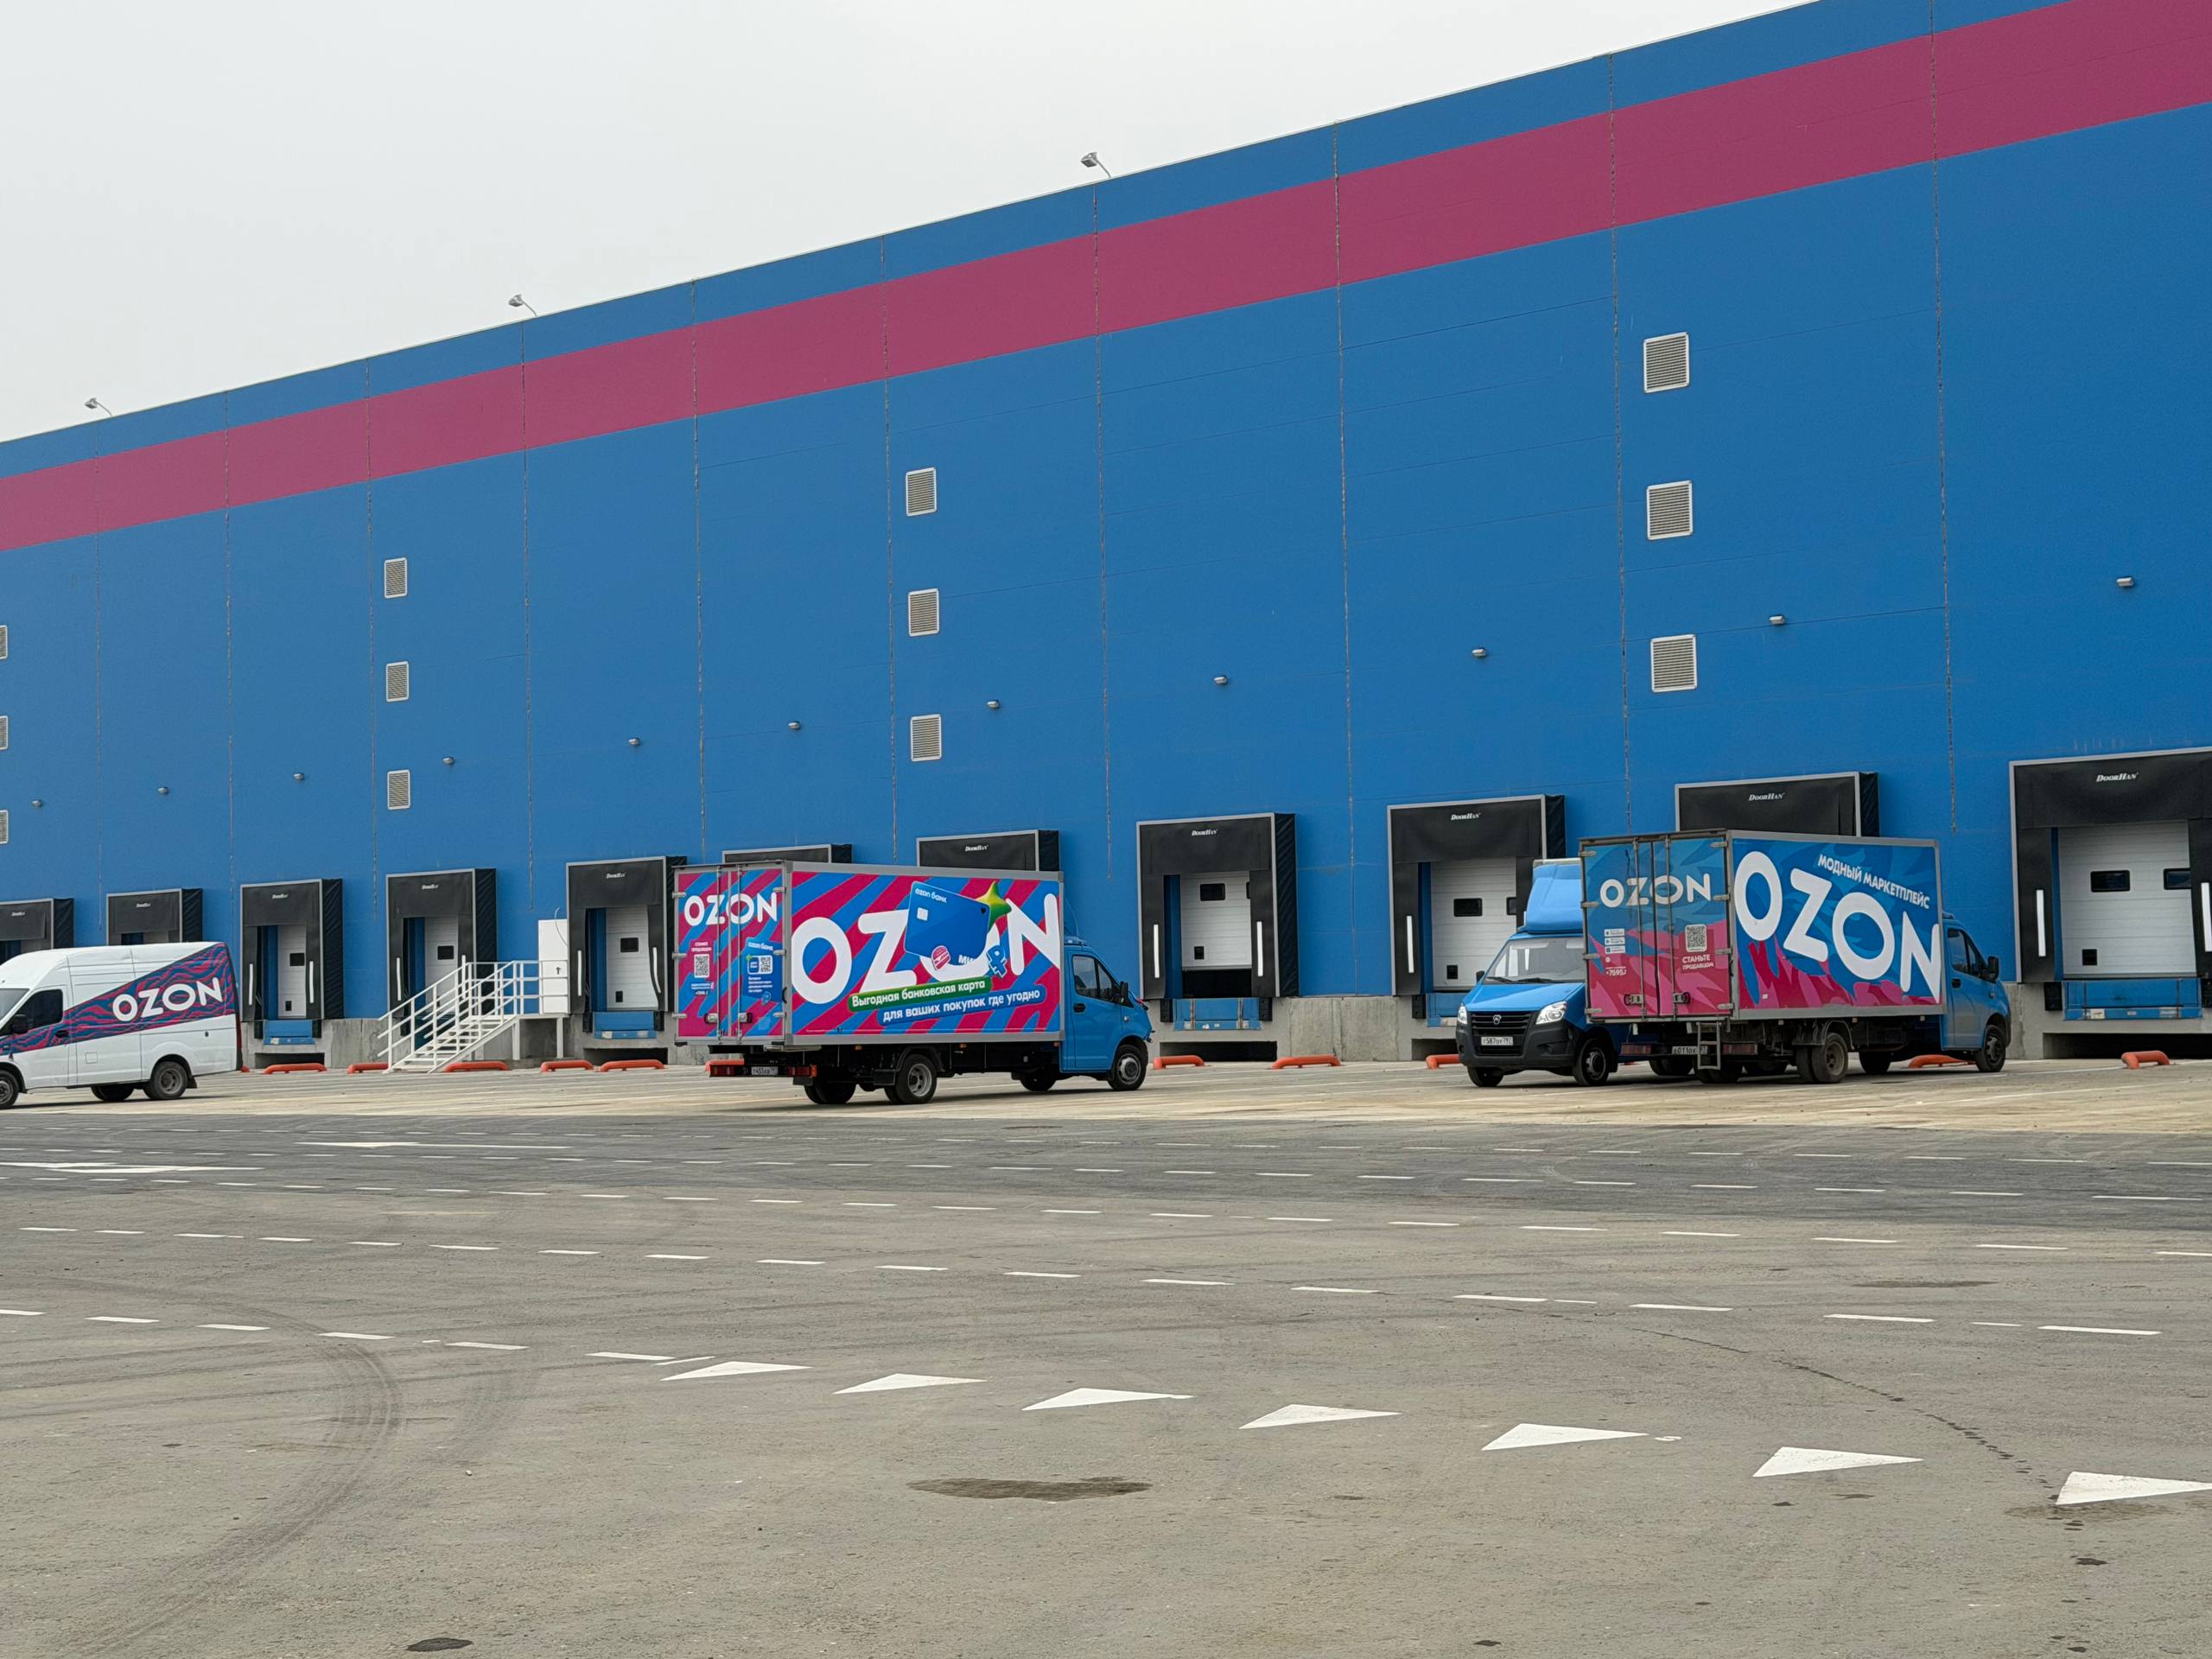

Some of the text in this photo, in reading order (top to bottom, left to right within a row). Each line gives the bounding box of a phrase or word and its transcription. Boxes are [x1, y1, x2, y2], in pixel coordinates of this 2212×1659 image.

[1599, 873, 1711, 908] OZON
[1818, 854, 1930, 910] МОДНЫЙ МАРКЕТПЛЕЙС
[683, 892, 779, 926] OZON
[1734, 851, 1941, 1003] OZON
[1682, 954, 1711, 963] СТАНЬТЕ
[112, 977, 223, 1021] OZON
[852, 978, 986, 1007] Выгодная банковская карта
[883, 989, 1040, 1023] для ваших покупок где угодно
